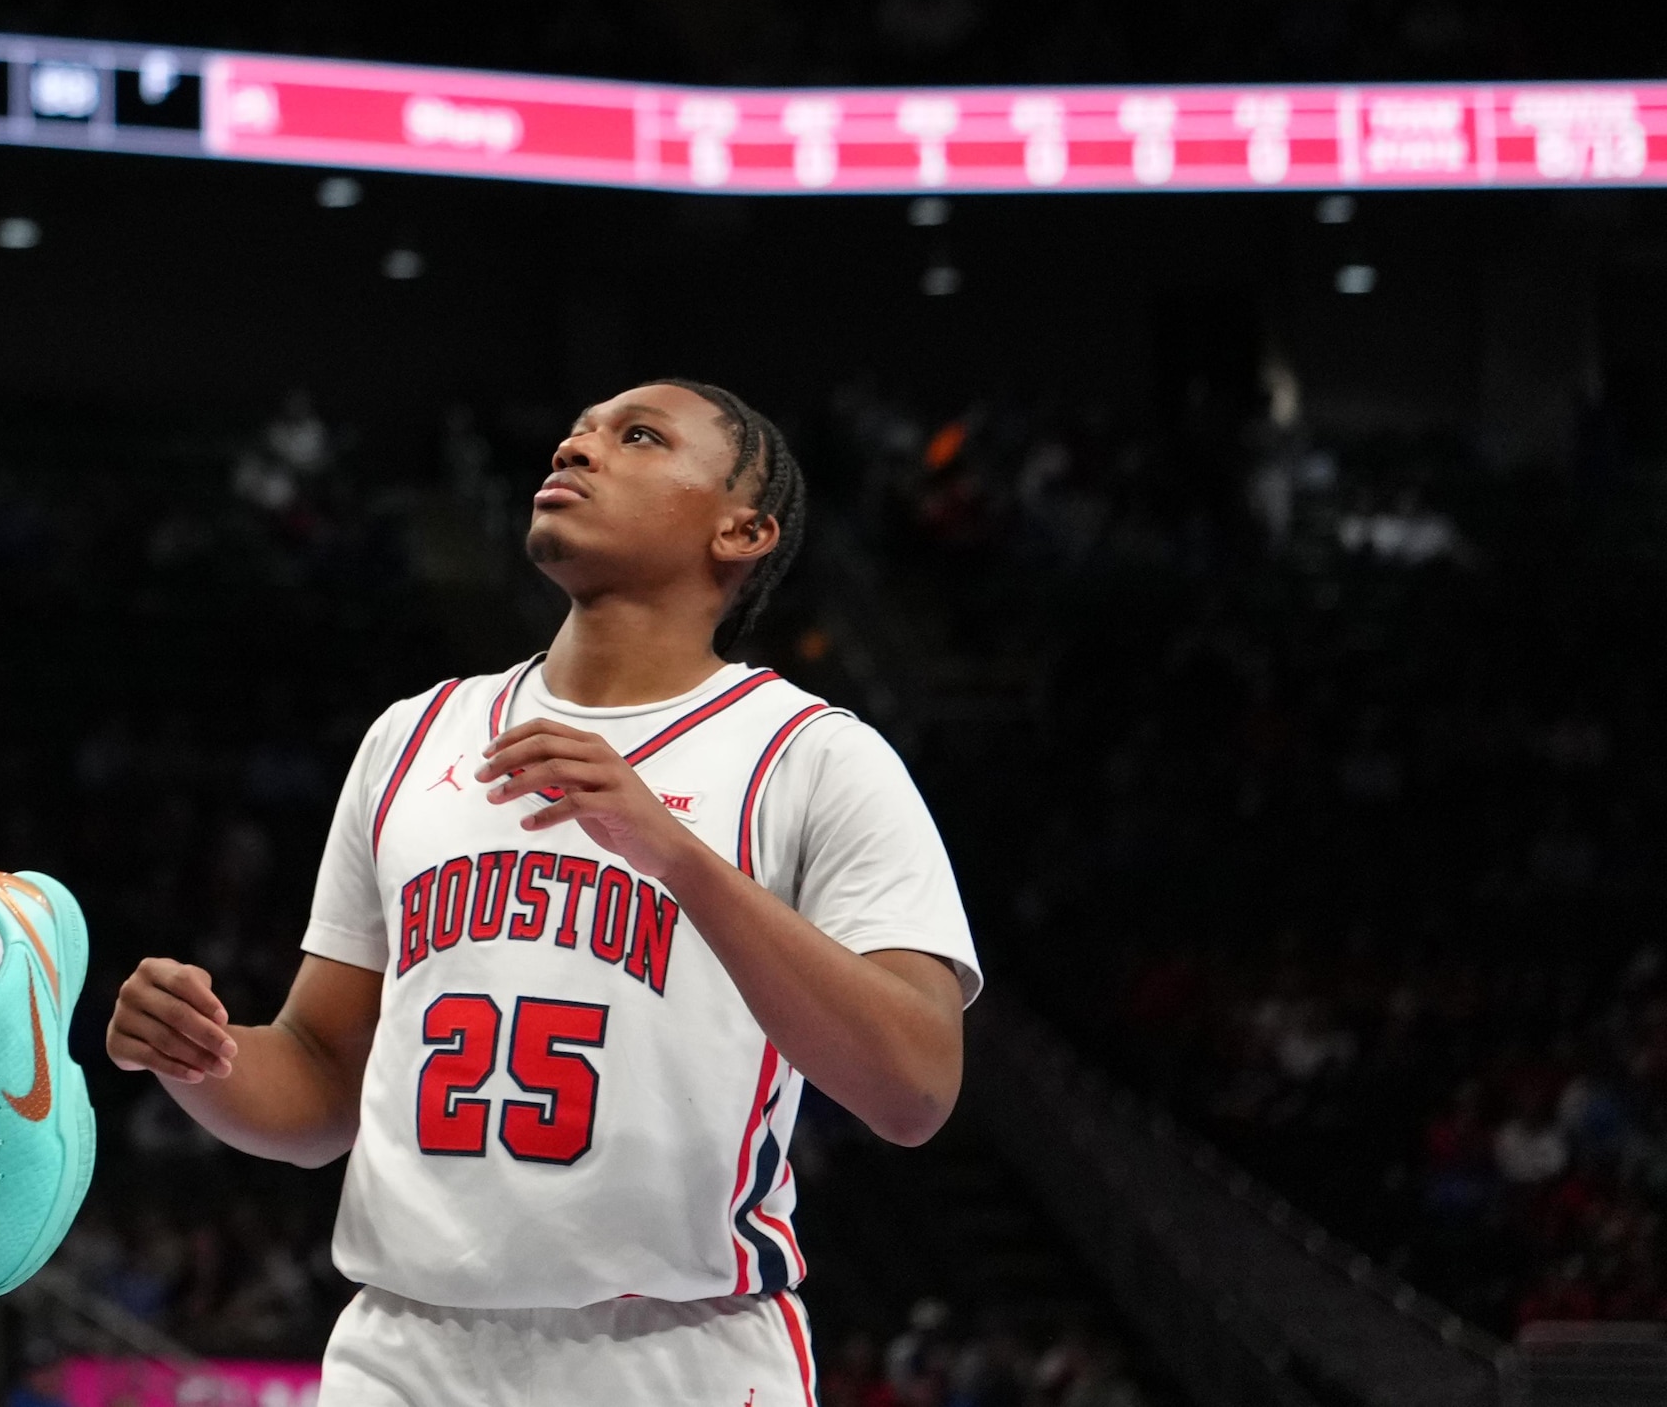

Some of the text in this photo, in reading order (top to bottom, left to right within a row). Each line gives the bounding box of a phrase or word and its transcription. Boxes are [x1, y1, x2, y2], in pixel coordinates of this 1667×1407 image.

[659, 793, 695, 813] XII
[396, 850, 678, 996] HOUSTON
[416, 992, 611, 1167] 25
